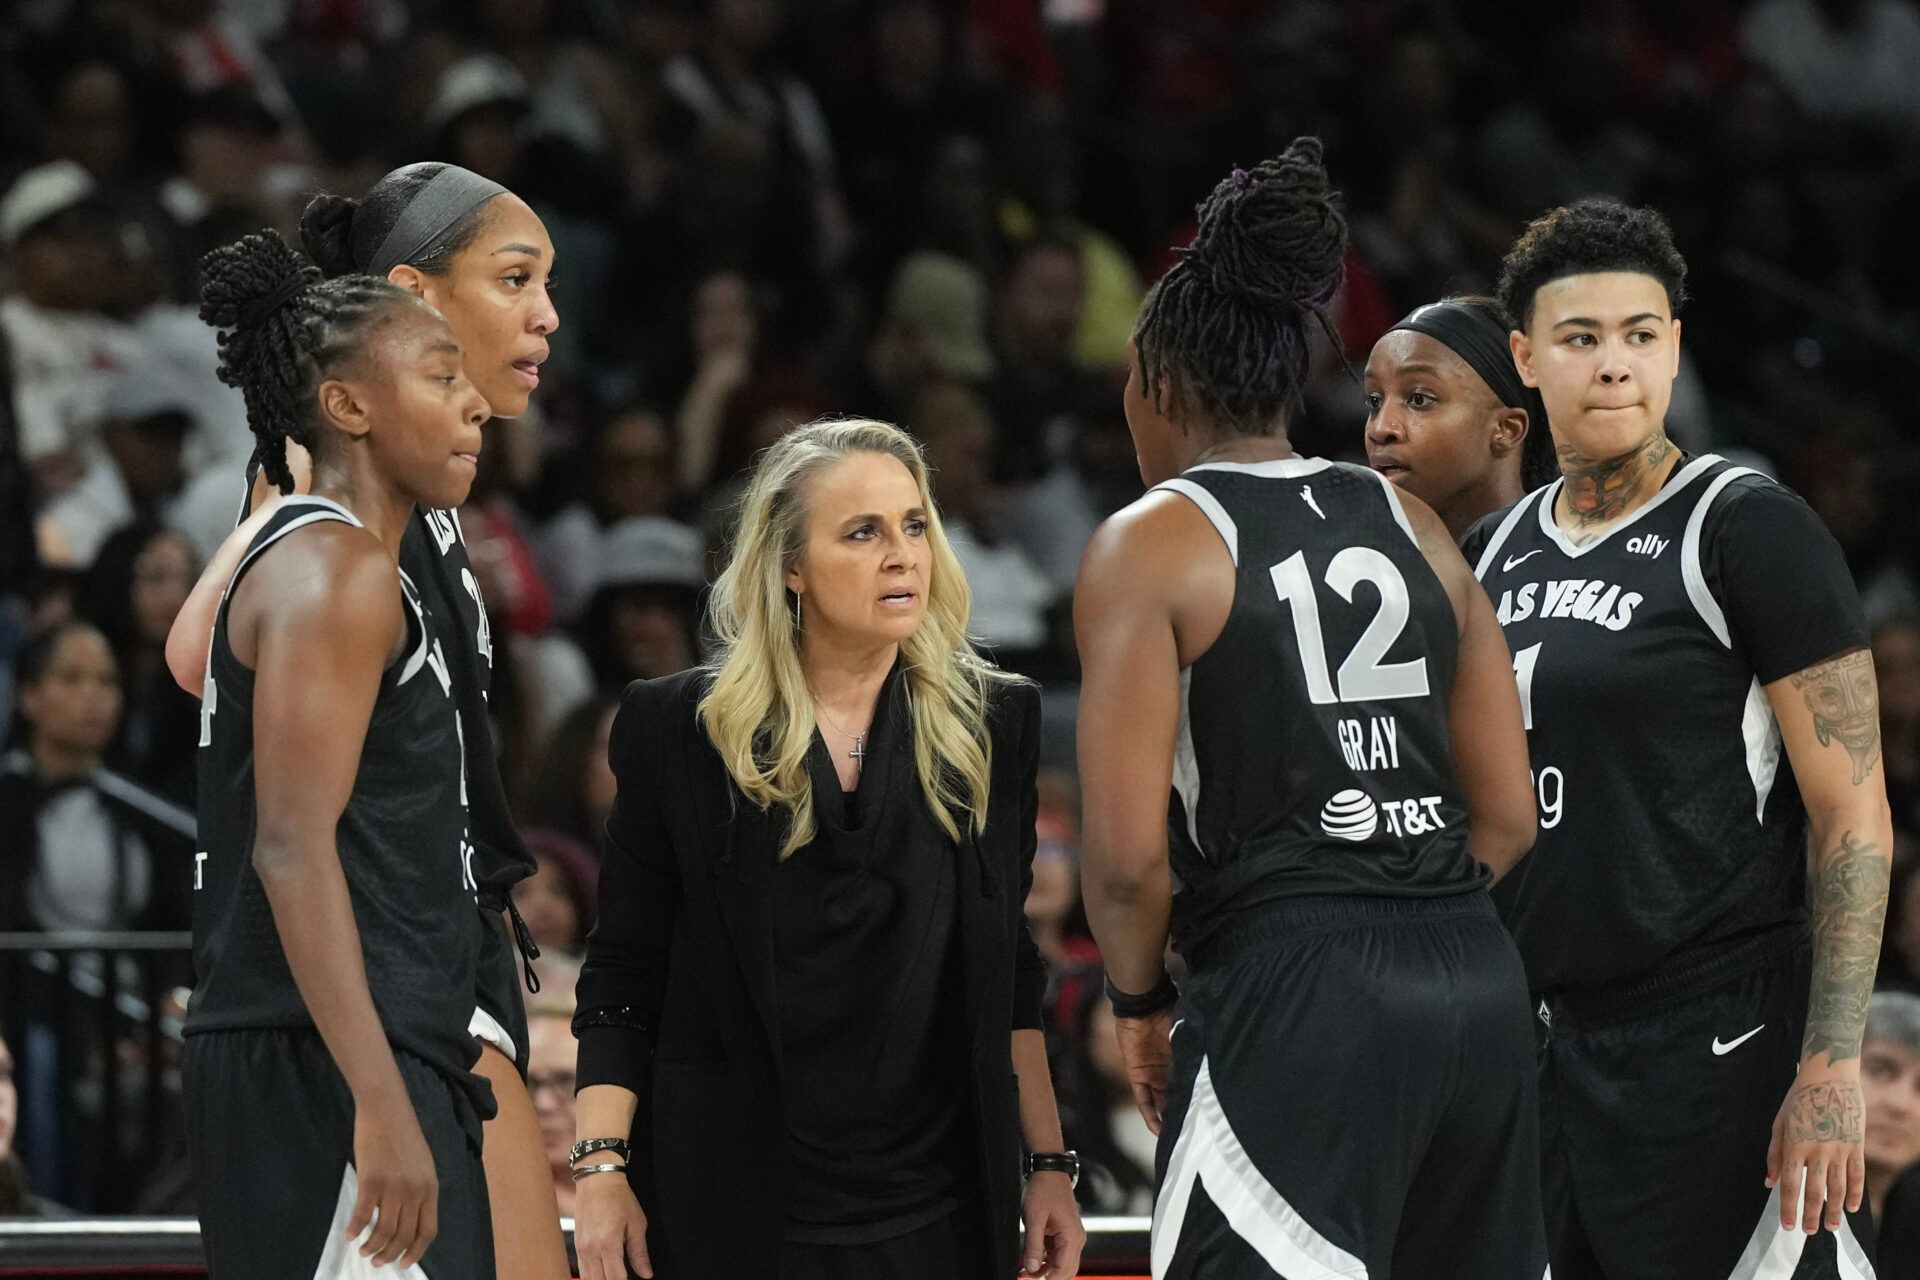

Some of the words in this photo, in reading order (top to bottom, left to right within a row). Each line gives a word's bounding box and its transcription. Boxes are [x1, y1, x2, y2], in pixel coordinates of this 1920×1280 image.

[1626, 533, 1670, 559] ally
[1269, 546, 1430, 704] 12
[1496, 582, 1540, 627] AS
[1539, 579, 1644, 631] VEGAS
[1337, 716, 1399, 771] GRAY
